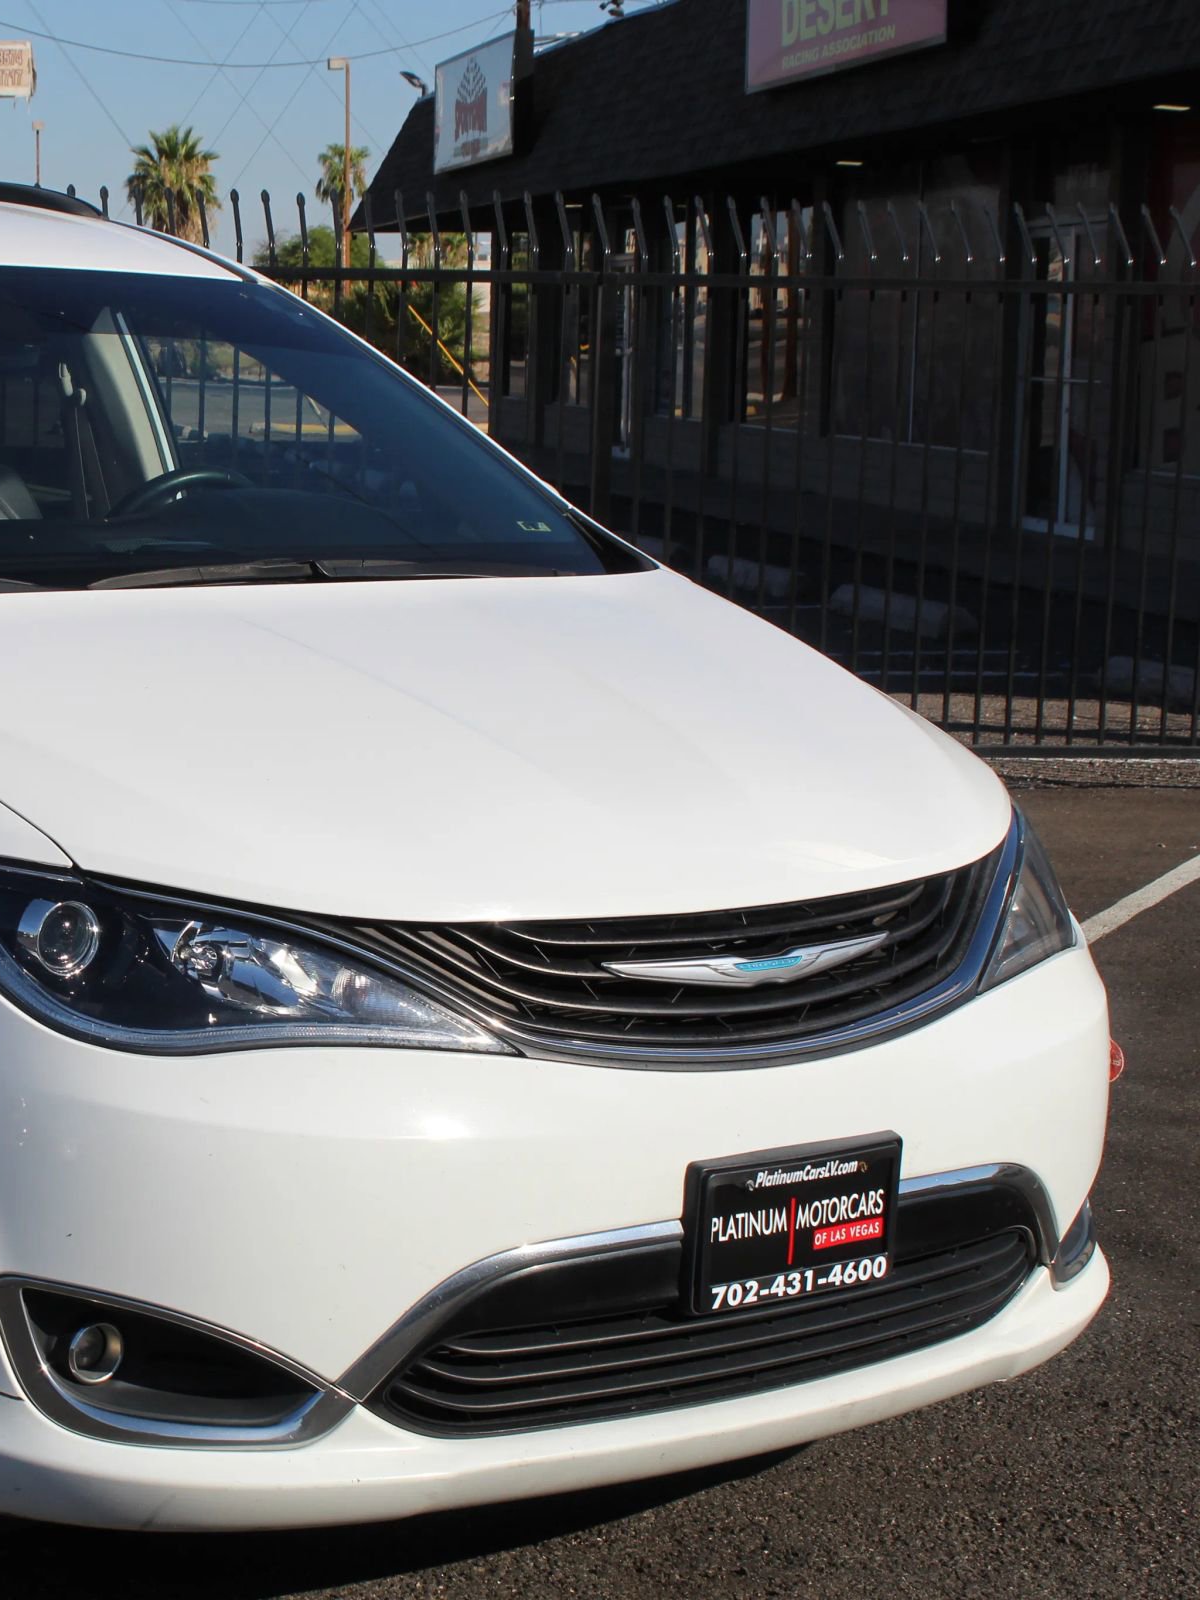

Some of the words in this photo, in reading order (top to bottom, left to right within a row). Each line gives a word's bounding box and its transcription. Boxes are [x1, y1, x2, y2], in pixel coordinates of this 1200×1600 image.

[782, 47, 819, 70] RACING
[823, 25, 896, 58] ASSOCIATION
[755, 1160, 859, 1188] PlatinumCarsLV.com
[711, 1207, 787, 1243] PLATINUM
[795, 1189, 885, 1230] MOTORCARS
[814, 1233, 827, 1246] OF
[830, 1227, 846, 1241] LAS
[850, 1221, 880, 1238] VEGAS
[711, 1255, 888, 1310] 702-431-4600
